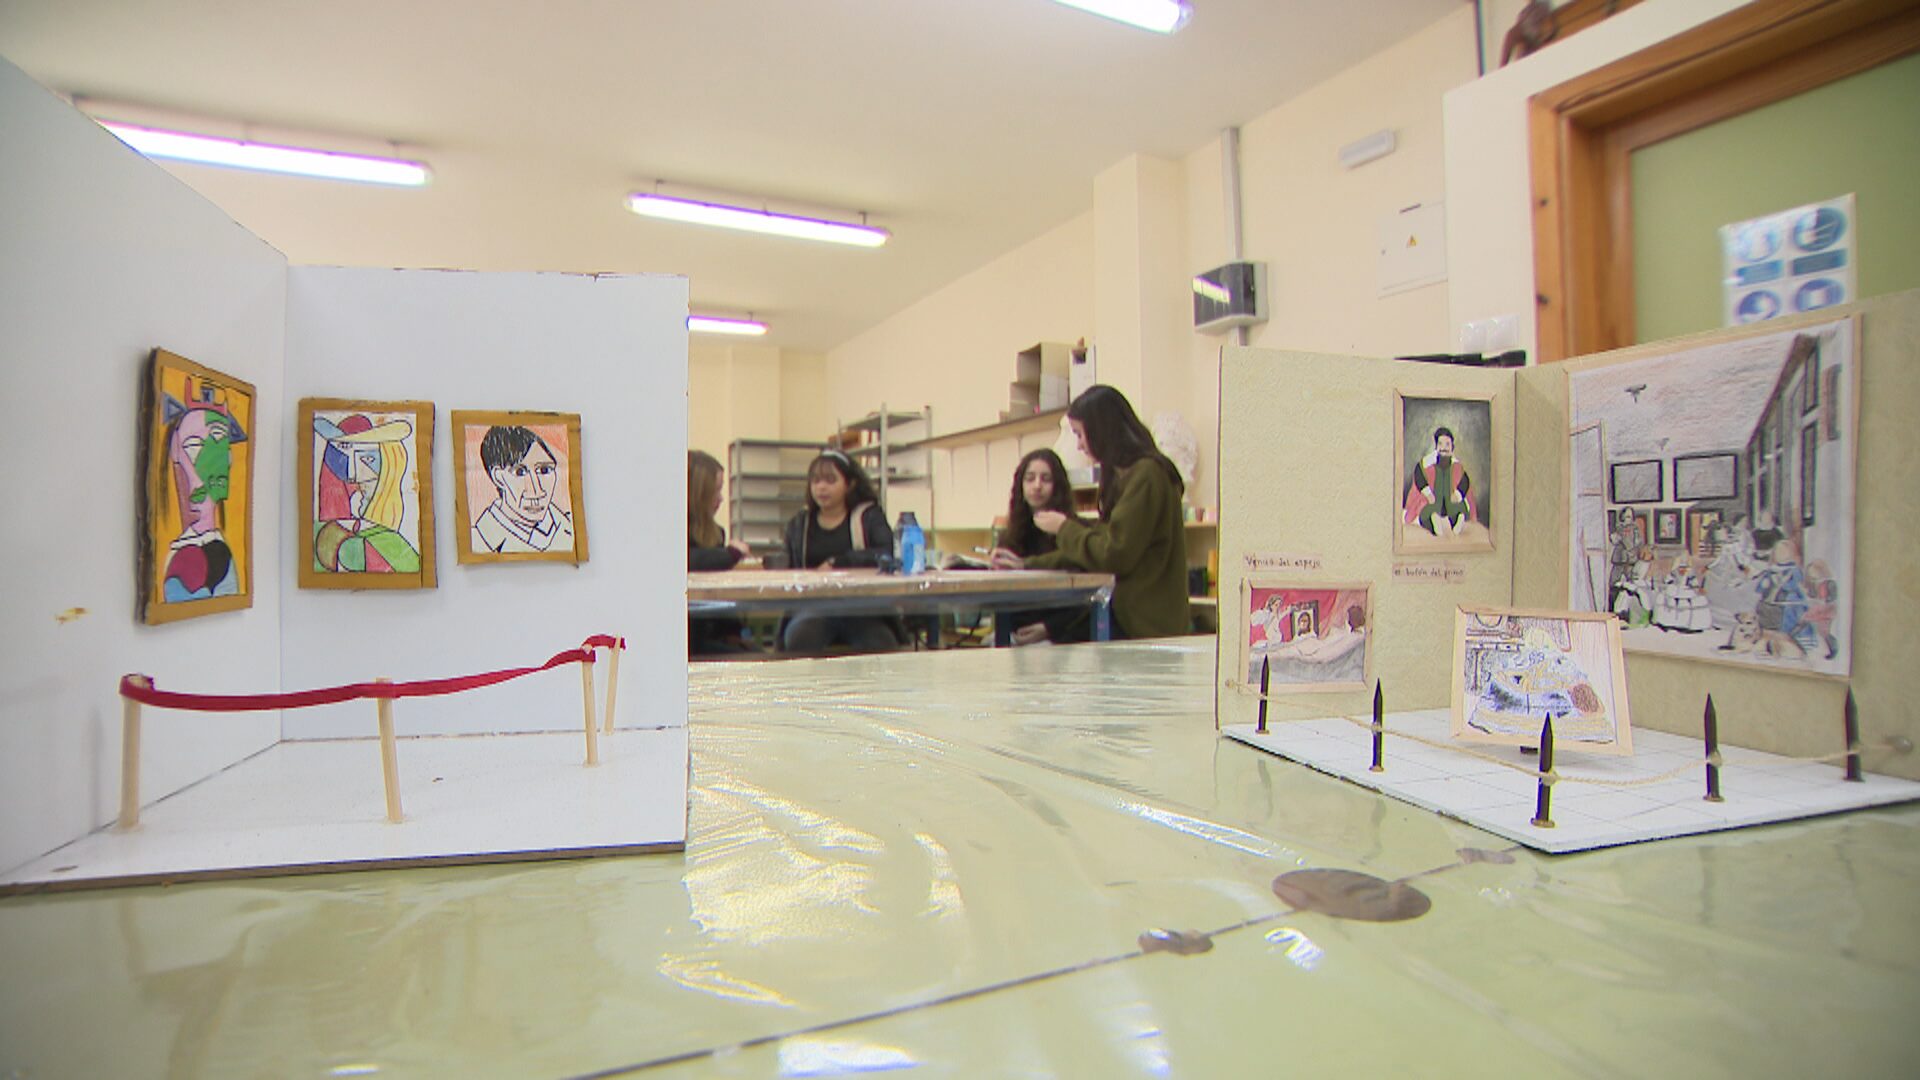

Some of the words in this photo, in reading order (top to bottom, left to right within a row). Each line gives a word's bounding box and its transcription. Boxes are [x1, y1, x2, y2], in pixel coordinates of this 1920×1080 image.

[1279, 557, 1290, 567] del
[1294, 559, 1321, 570] espejo
[1430, 567, 1442, 577] del
